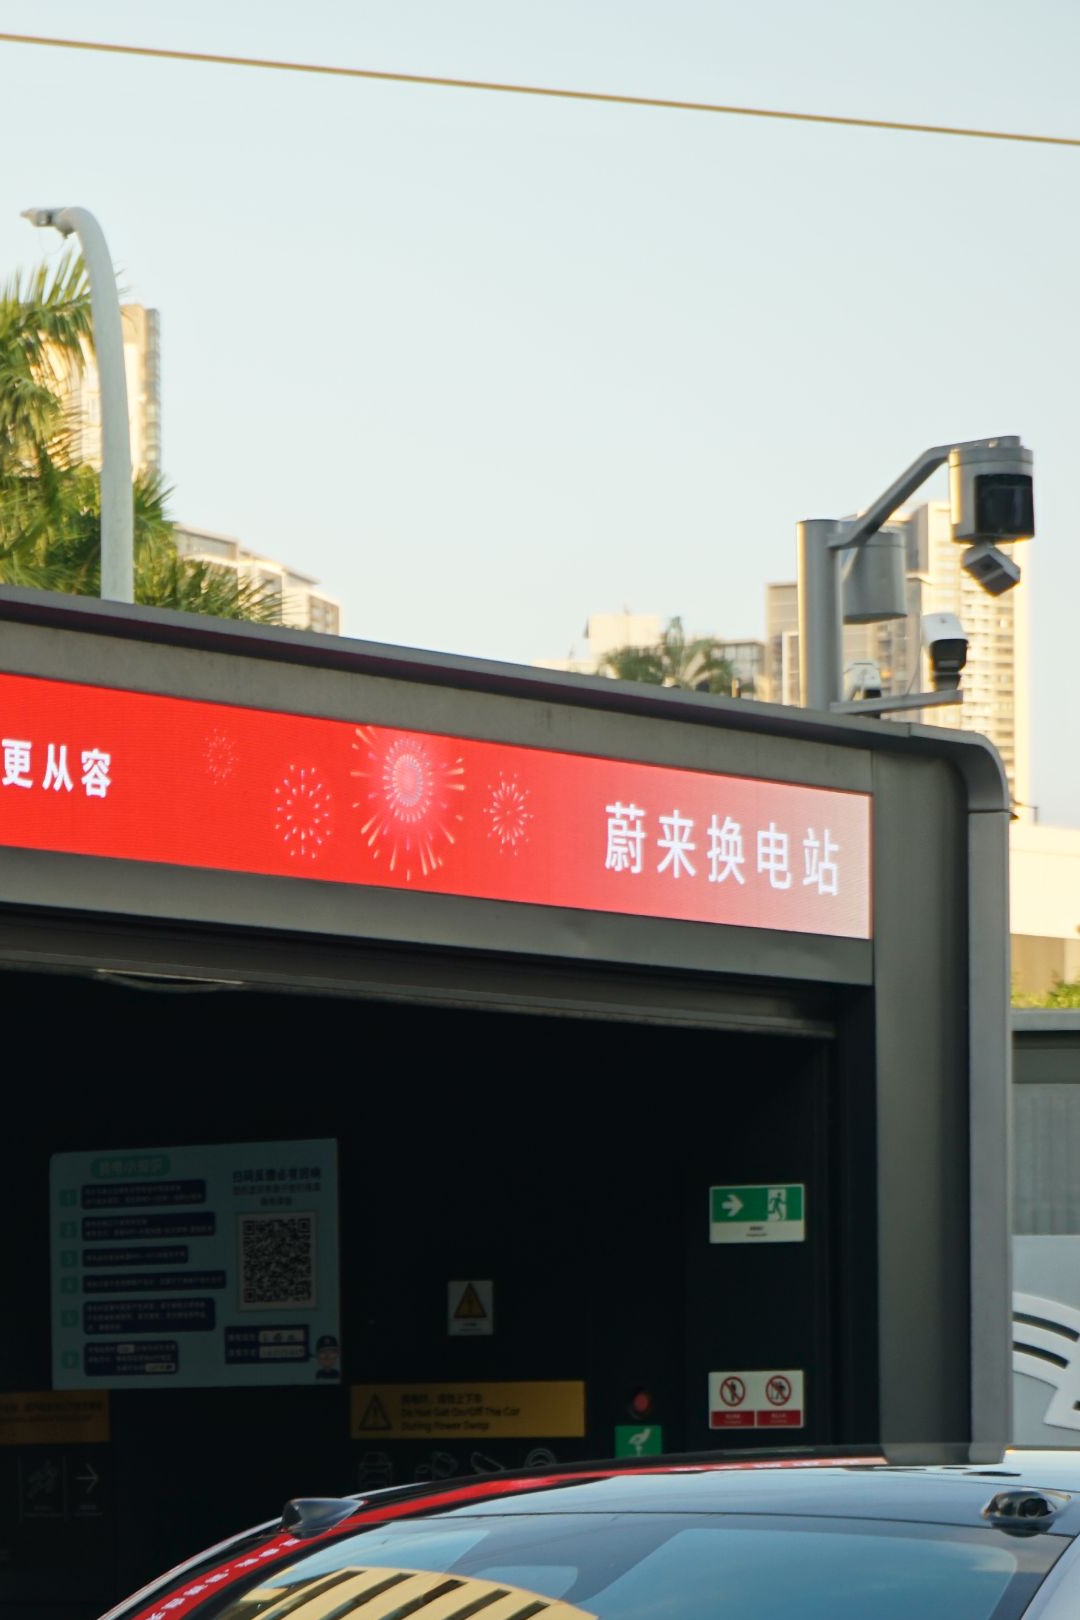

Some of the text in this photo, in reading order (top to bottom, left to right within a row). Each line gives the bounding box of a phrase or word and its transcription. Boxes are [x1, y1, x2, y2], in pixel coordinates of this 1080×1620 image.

[605, 801, 840, 896] 蔚来换电站
